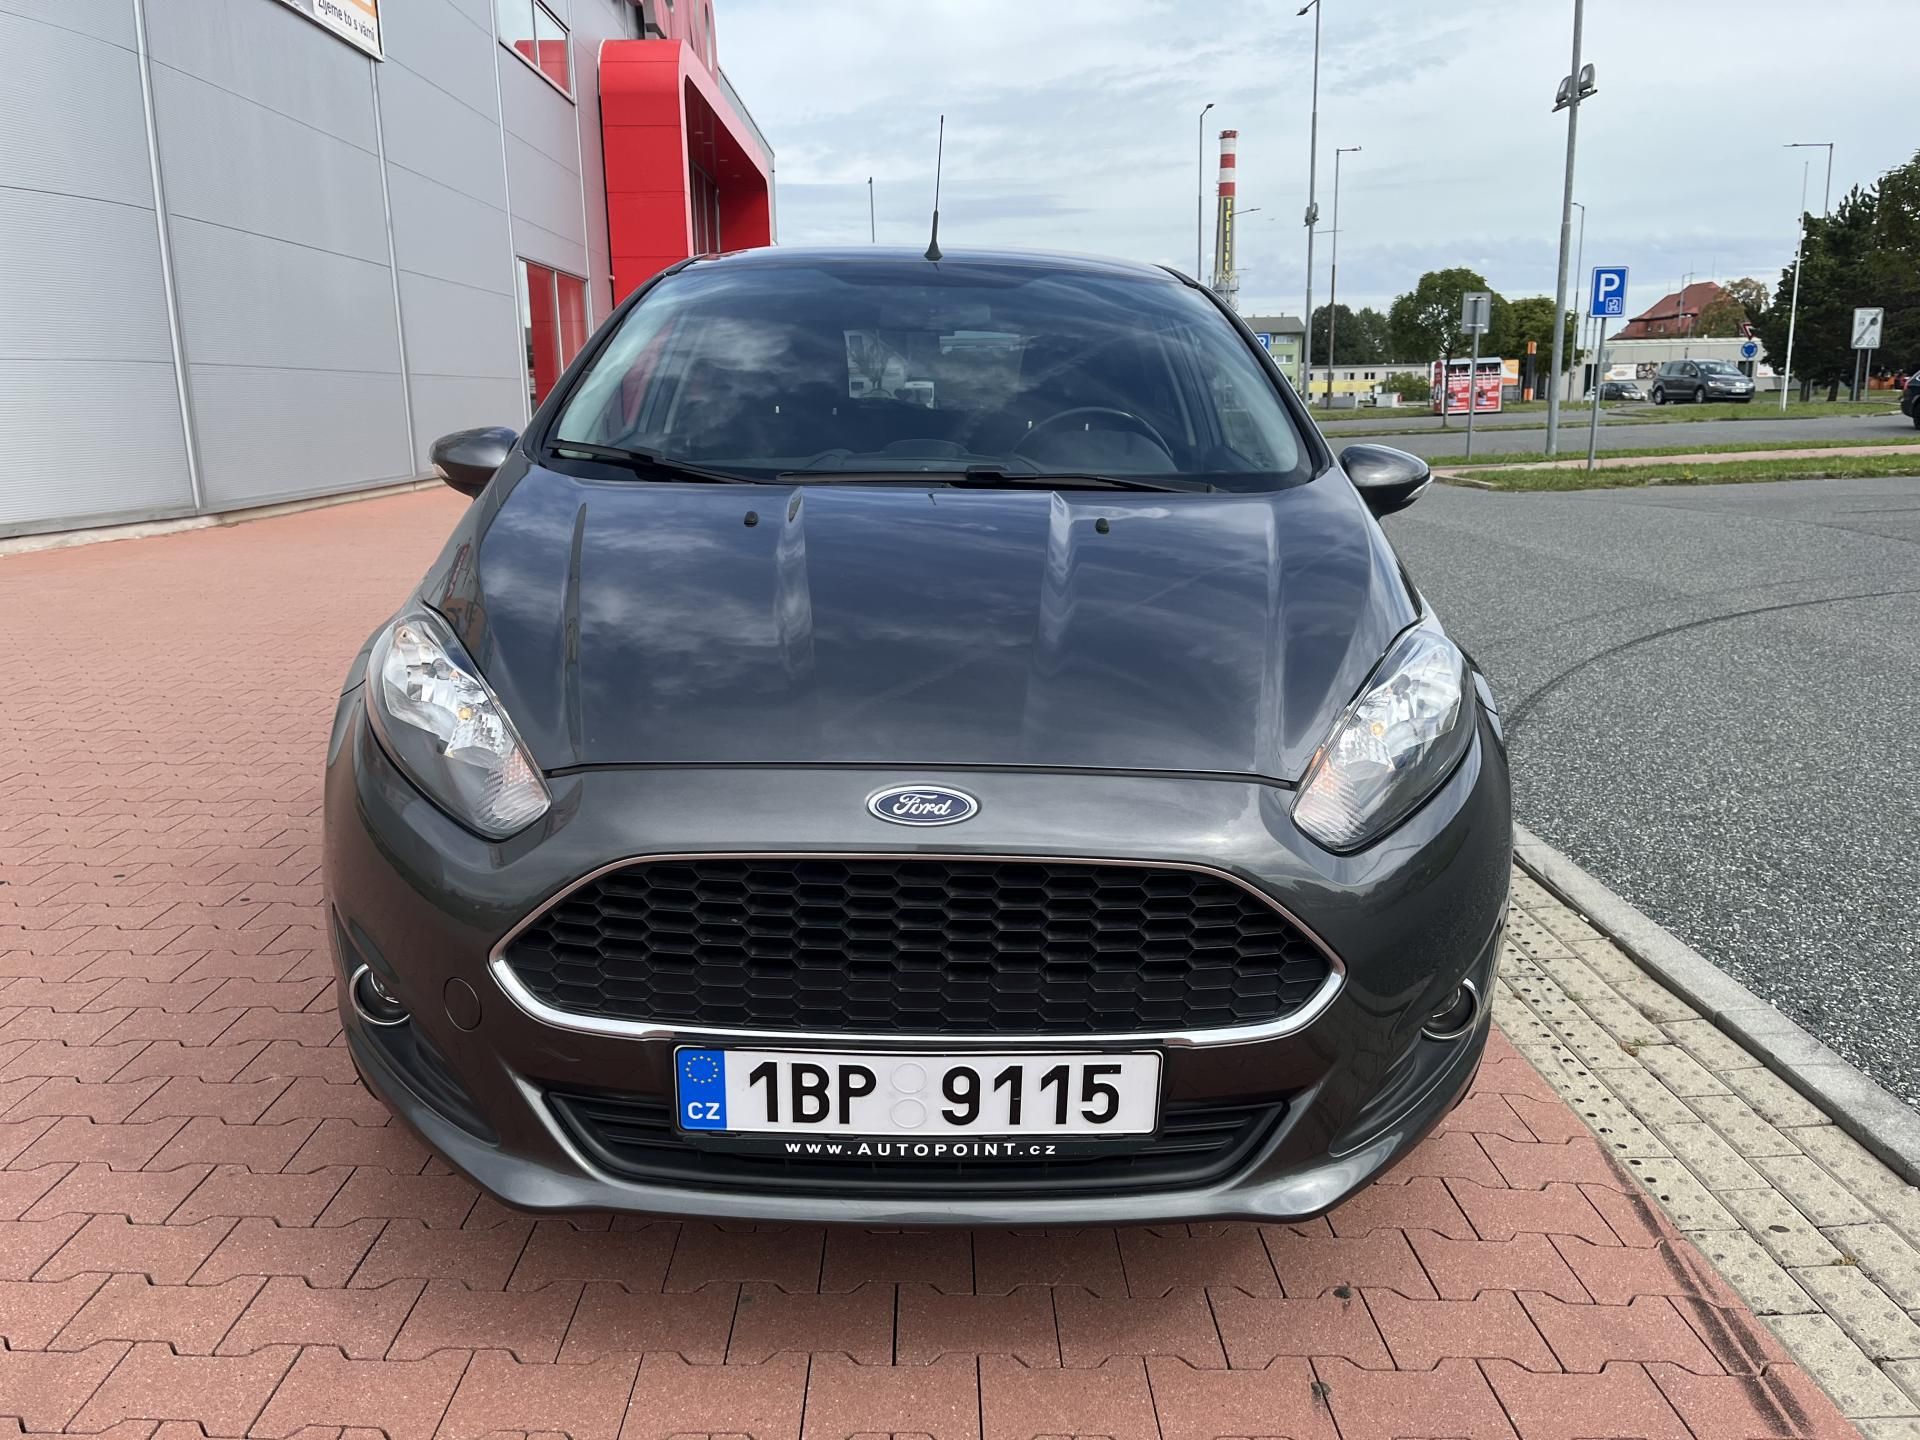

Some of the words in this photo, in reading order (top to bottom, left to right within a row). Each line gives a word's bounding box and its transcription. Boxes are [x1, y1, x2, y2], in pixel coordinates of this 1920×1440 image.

[343, 10, 352, 26] to
[353, 19, 358, 31] s
[358, 21, 375, 42] vámi
[1598, 273, 1621, 302] P
[892, 793, 952, 816] Ford
[749, 1061, 877, 1125] 1BP
[941, 1064, 1122, 1126] 9115
[687, 1101, 721, 1121] CZ
[785, 1142, 1056, 1157] www.AUTOPOINT.cz
